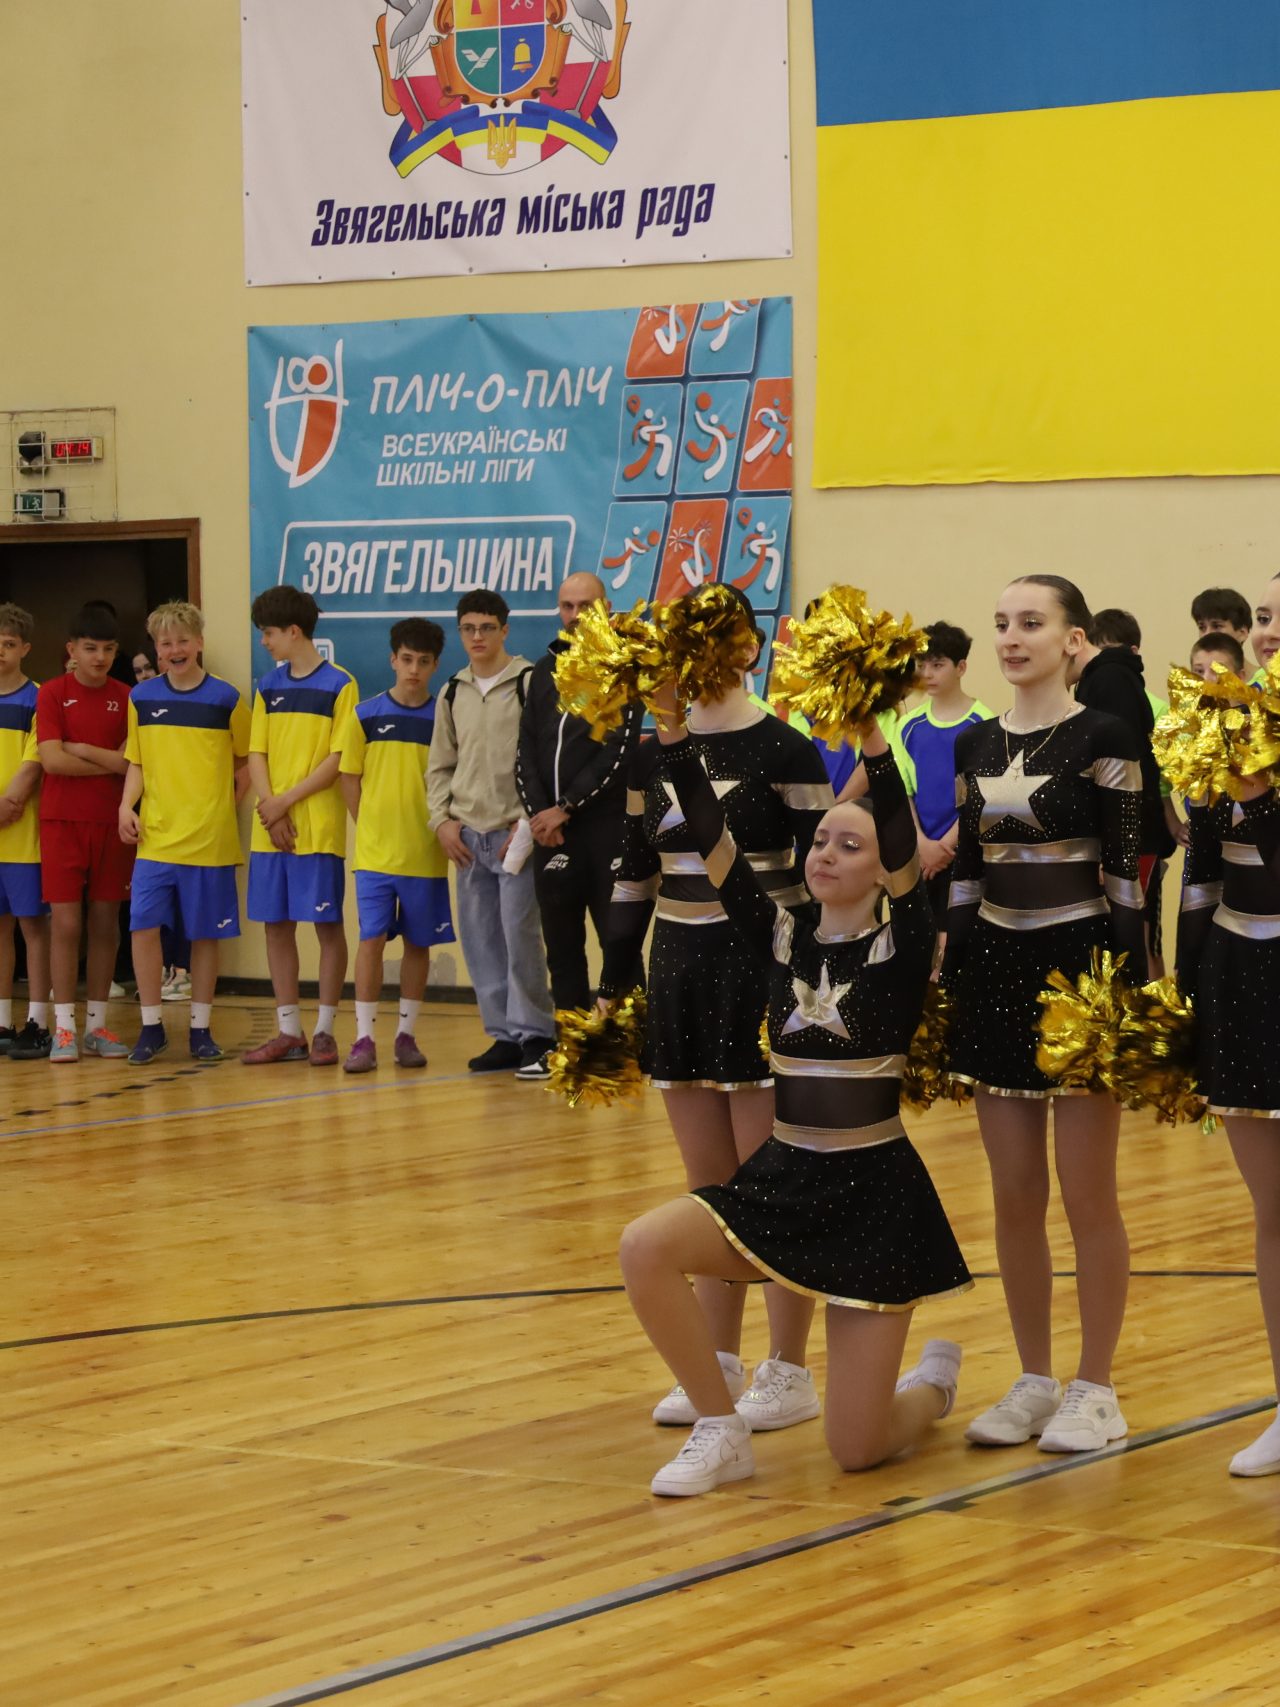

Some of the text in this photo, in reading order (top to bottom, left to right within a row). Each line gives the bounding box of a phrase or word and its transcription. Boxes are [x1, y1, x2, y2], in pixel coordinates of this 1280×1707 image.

[311, 183, 716, 247] Звягельська міська рада
[370, 366, 613, 415] ПЛІЧ-О-ПЛІЧ
[382, 426, 568, 458] ВСЕУКРАЇНСЬКІ
[376, 457, 536, 487] ШКІЛЬНІ ЛІГИ
[302, 536, 553, 595] ЗВЯГЕЛЬЩИНА
[106, 700, 119, 712] 22
